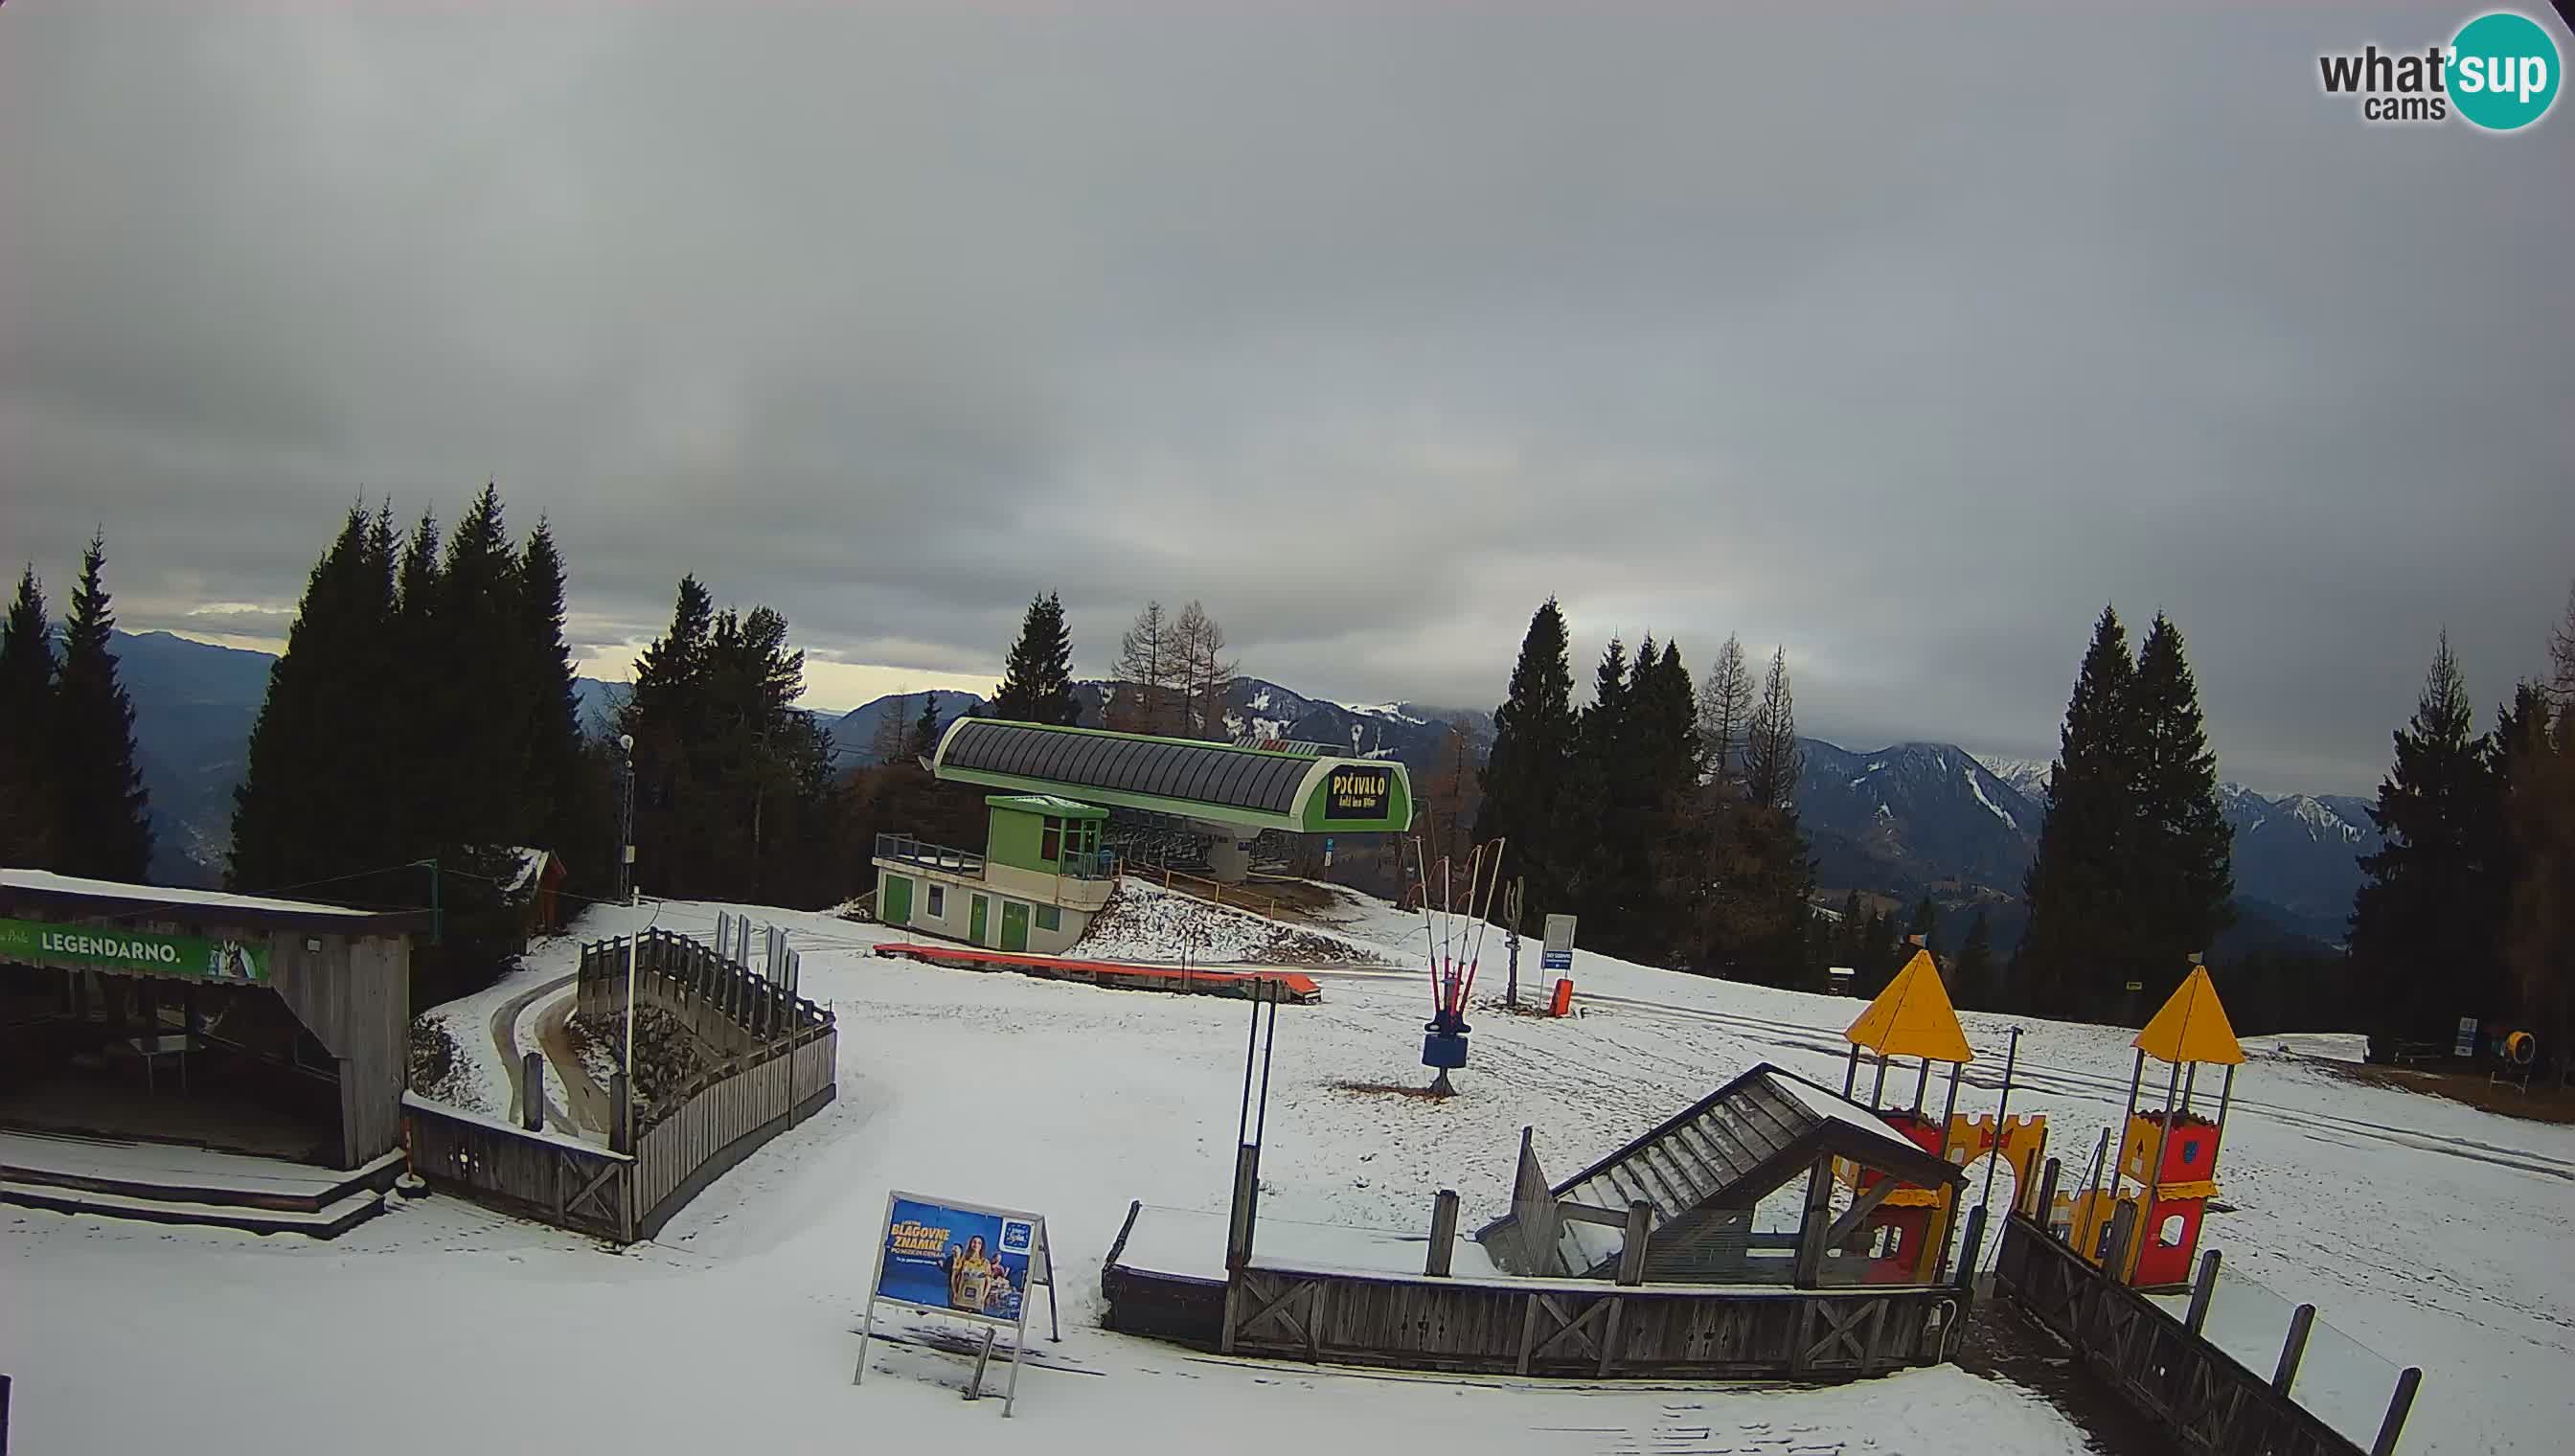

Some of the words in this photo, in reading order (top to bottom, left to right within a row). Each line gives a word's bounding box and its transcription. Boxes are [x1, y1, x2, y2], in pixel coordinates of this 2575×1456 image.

[42, 932, 181, 963] LEGENDARNO.
[891, 1223, 950, 1240] BLAGOVNE
[893, 1237, 945, 1252] ZNAMKE
